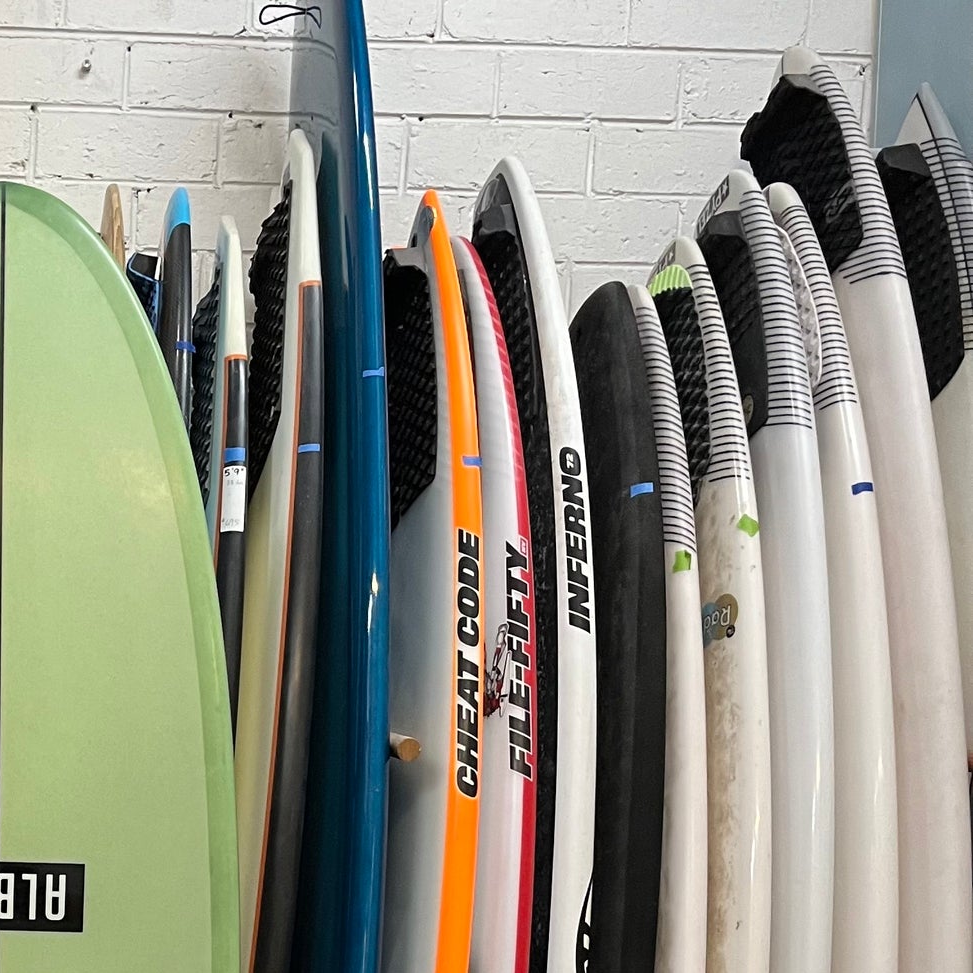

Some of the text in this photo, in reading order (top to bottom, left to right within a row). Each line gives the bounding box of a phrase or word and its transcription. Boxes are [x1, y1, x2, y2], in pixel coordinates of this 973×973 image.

[559, 447, 591, 634] INFERNO
[566, 453, 574, 469] 72
[456, 528, 480, 798] CHEAT CODE
[505, 540, 532, 779] FILE-FIFTY
